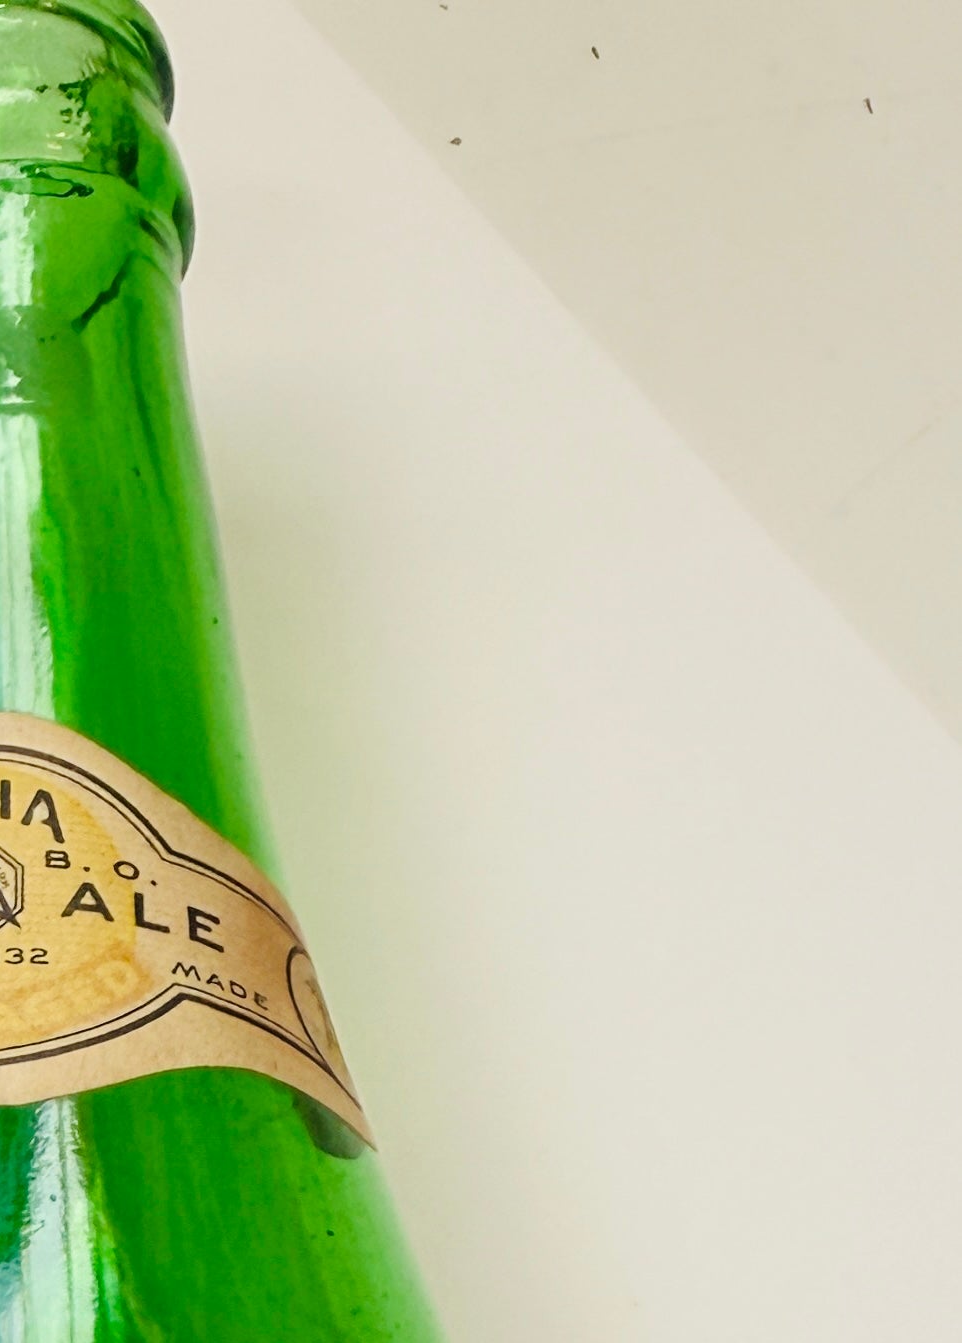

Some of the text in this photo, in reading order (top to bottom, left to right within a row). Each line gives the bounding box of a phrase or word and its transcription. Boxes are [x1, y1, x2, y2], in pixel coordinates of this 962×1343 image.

[44, 850, 91, 873] B.
[113, 860, 159, 886] O.
[61, 881, 225, 954] ALE
[171, 961, 269, 1011] MADE
